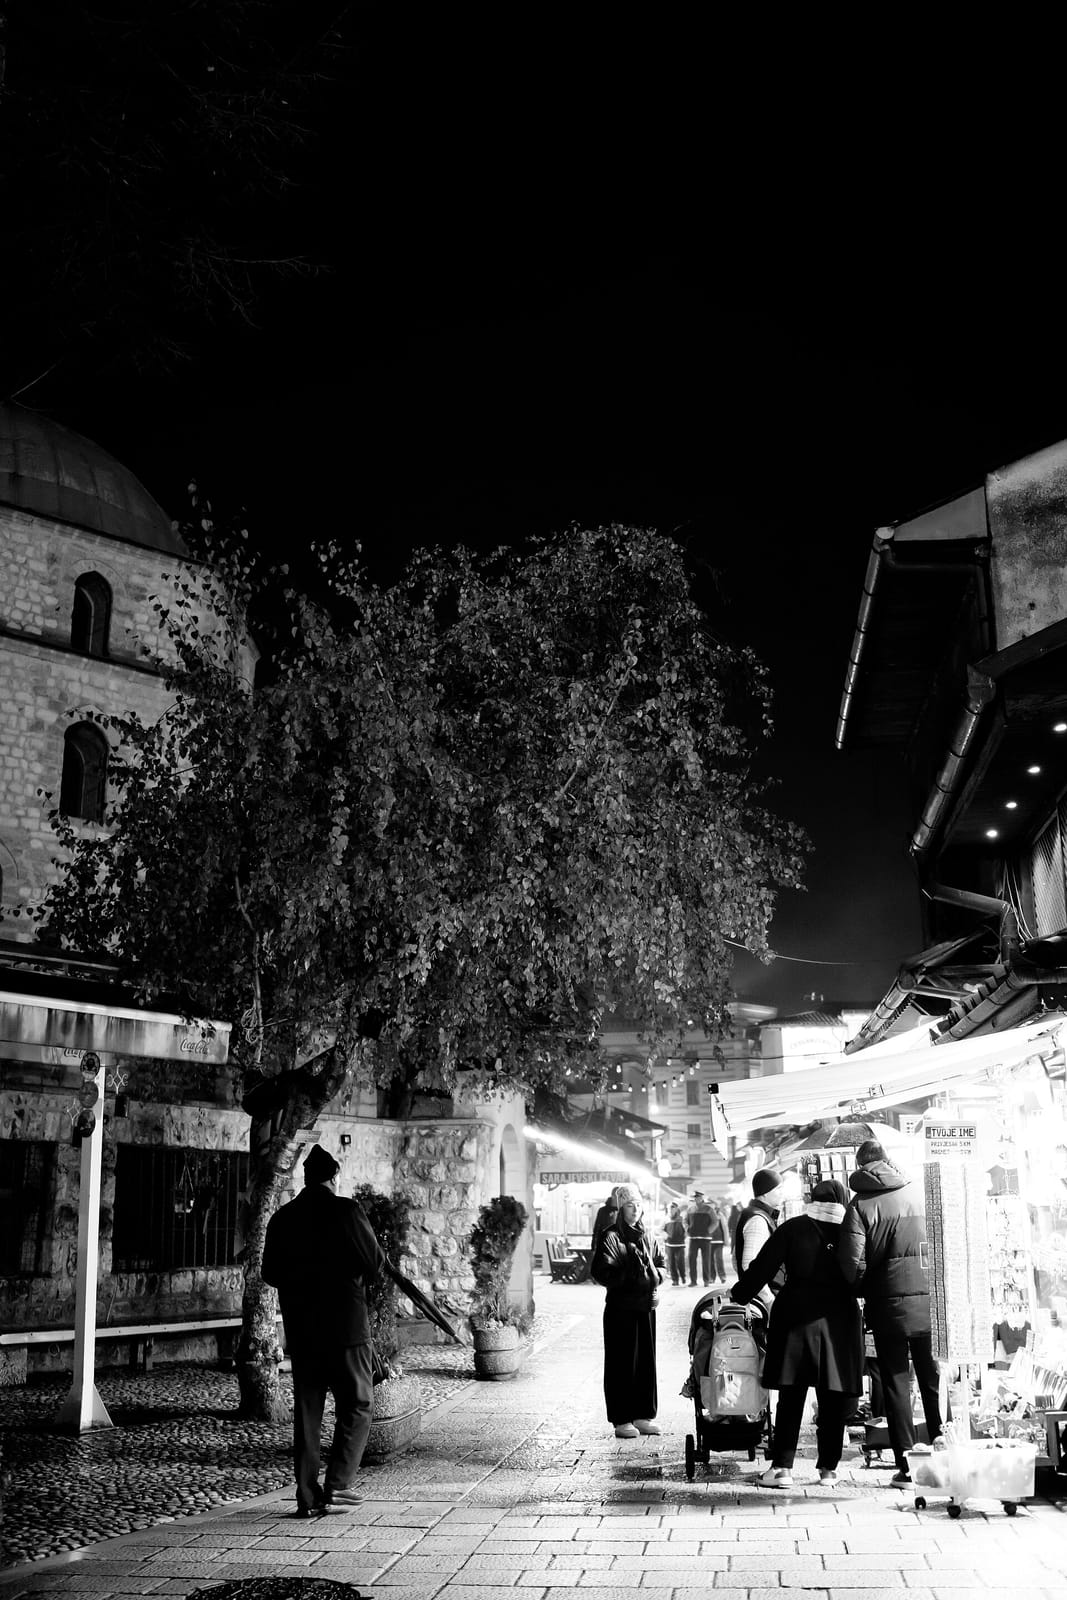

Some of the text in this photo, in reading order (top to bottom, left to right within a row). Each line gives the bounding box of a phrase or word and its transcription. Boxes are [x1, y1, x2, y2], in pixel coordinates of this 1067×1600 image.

[932, 1128, 974, 1137] TVOJE IME
[542, 1173, 597, 1184] SARAJEVSKI
